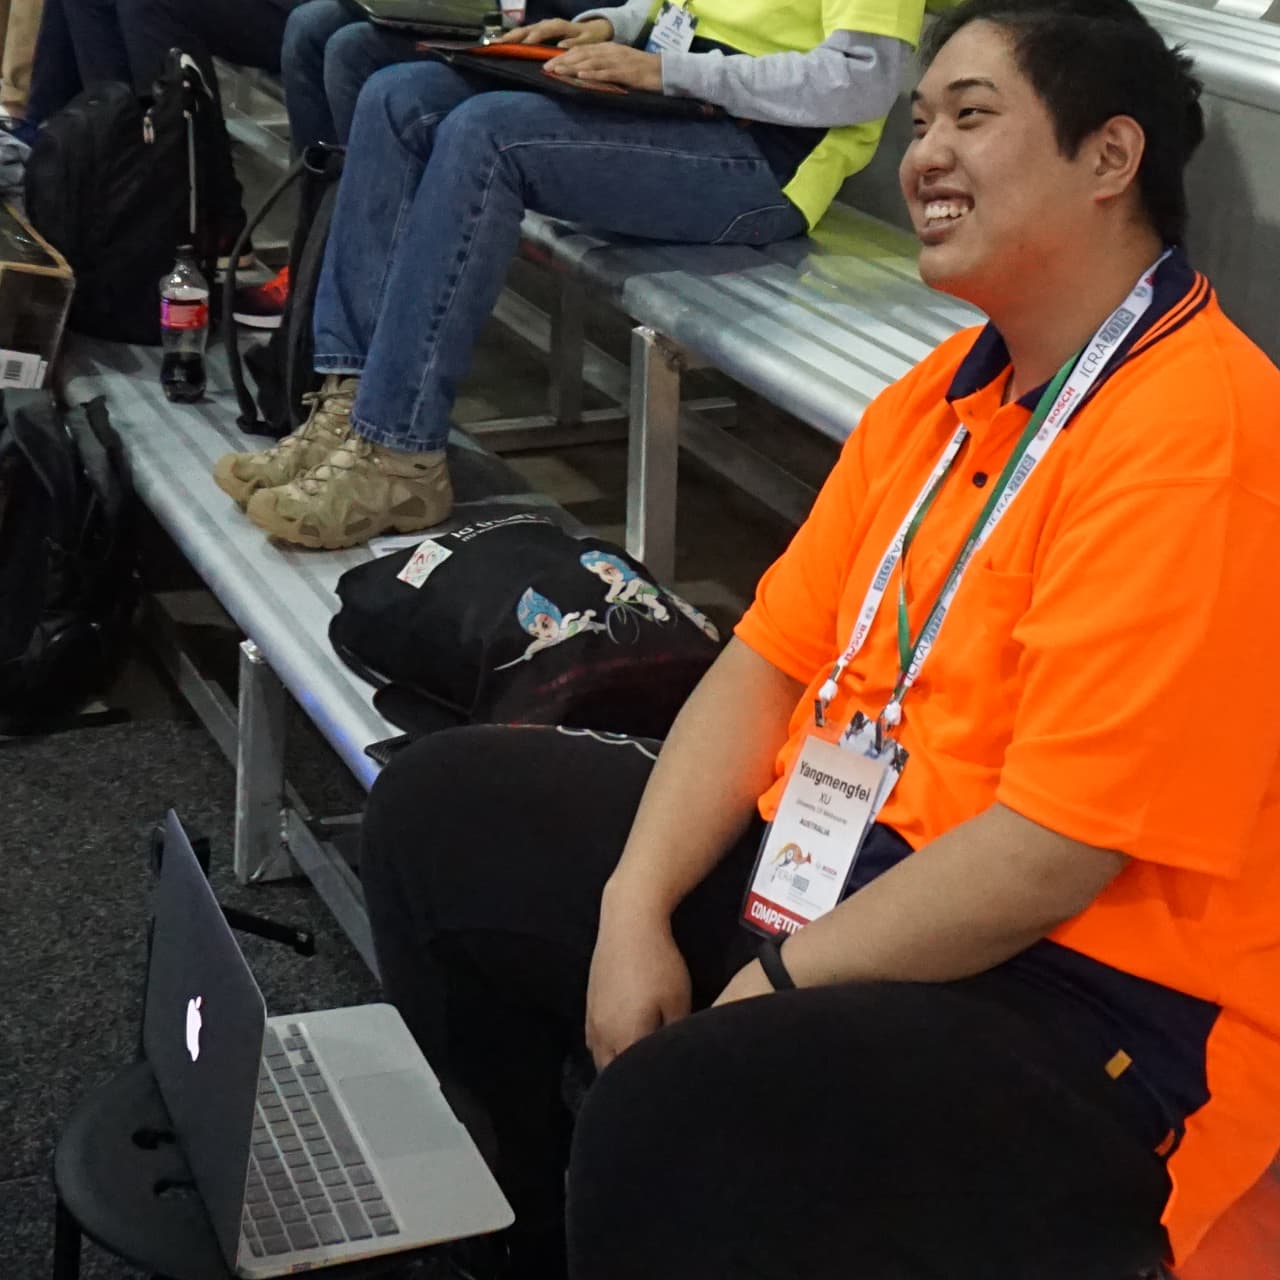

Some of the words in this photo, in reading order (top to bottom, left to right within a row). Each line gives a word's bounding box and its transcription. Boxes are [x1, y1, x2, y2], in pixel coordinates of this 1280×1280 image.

[1079, 307, 1136, 379] ICRA2018
[1047, 386, 1077, 425] BOSCH
[799, 760, 872, 803] Yangmengfei
[818, 792, 832, 806] XU
[799, 818, 831, 837] AUSTRALIA
[750, 901, 804, 936] COMPETIT
